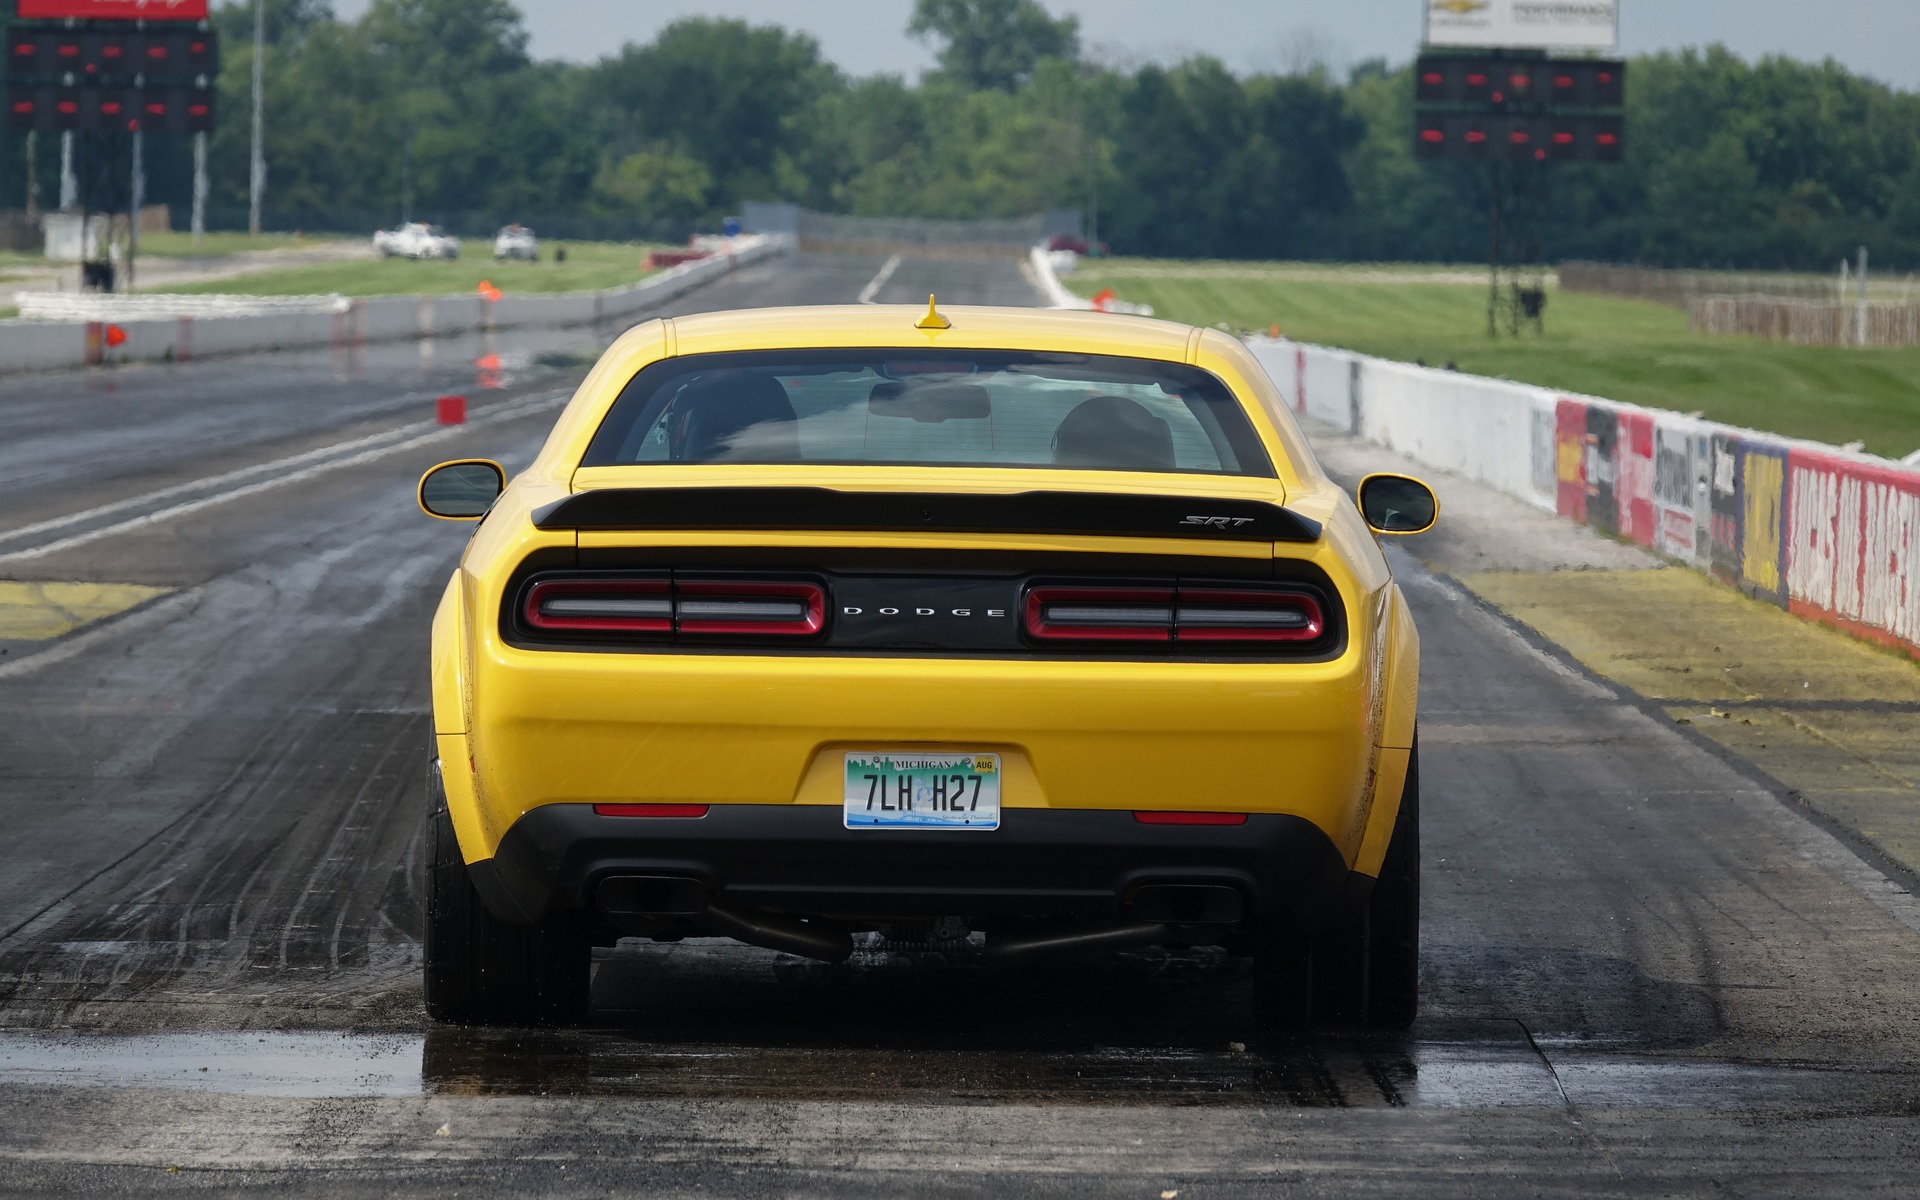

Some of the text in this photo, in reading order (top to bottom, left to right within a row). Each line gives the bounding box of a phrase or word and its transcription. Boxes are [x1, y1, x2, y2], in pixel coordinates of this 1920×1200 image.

[1180, 515, 1255, 530] SRT
[843, 606, 1005, 617] DODGE
[895, 760, 952, 769] MICHIGAN
[976, 761, 992, 769] AUG
[863, 774, 982, 811] 7LH H27
